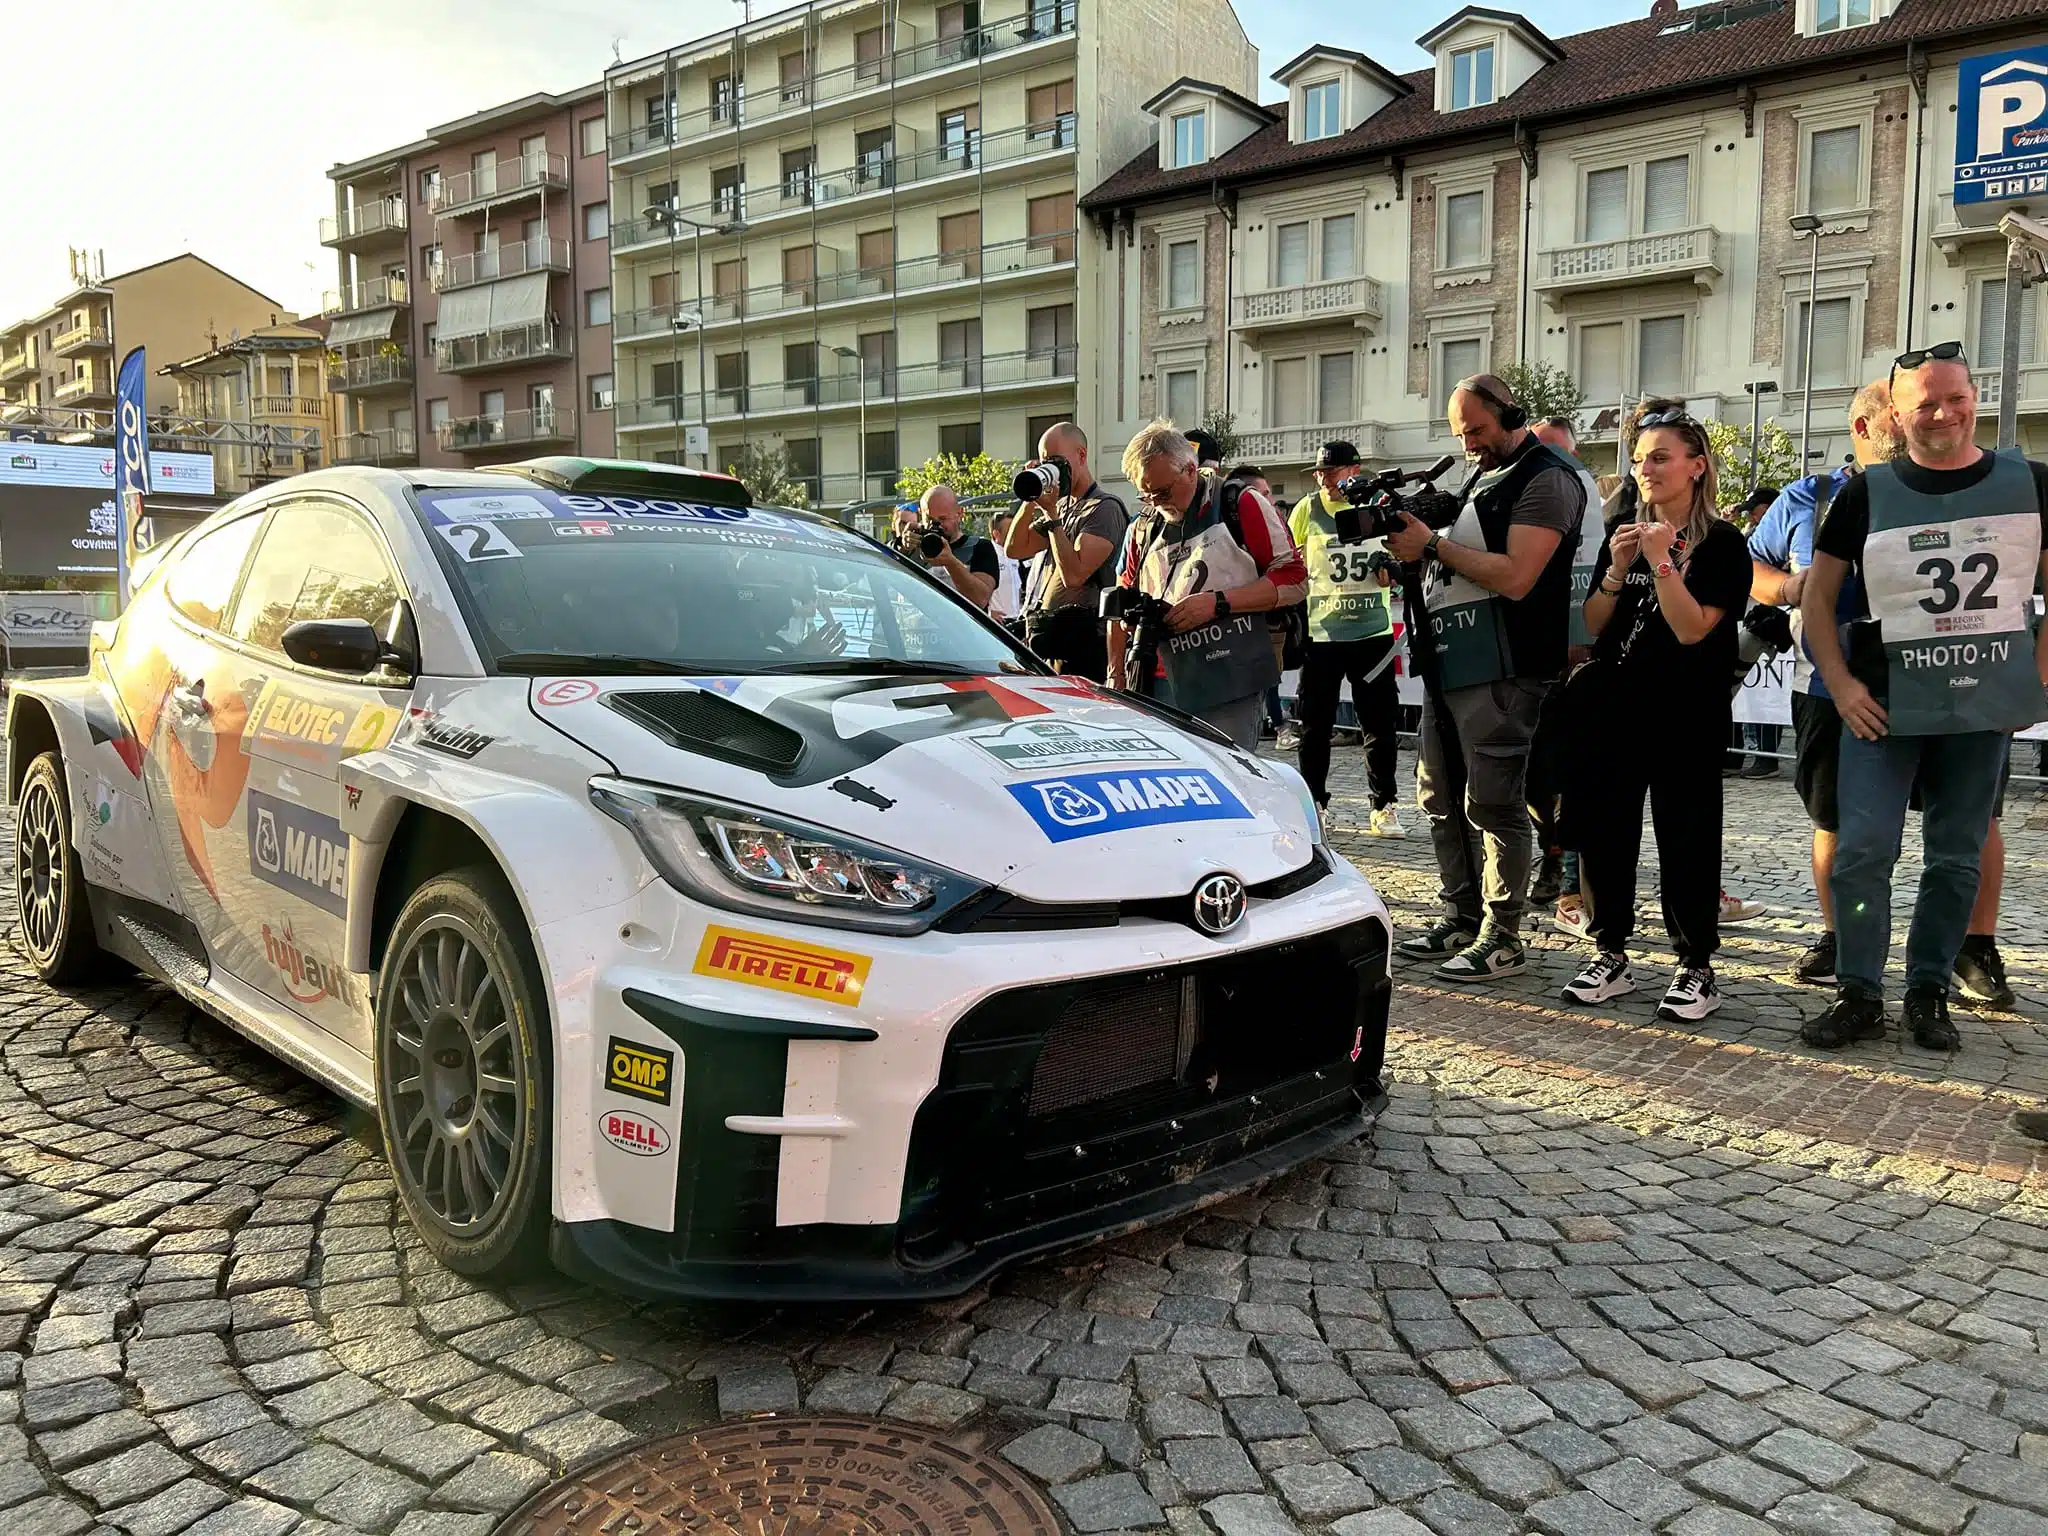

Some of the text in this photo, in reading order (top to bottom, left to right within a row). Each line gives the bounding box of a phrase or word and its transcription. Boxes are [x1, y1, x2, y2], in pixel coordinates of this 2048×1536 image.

[1977, 80, 2046, 155] P
[1980, 165, 2014, 175] Piazza
[2017, 160, 2037, 170] San
[559, 495, 788, 529] sparco
[450, 525, 509, 558] 2
[556, 526, 612, 536] GR
[612, 523, 701, 535] TOYOTA
[703, 527, 777, 541] GAZOO
[1329, 552, 1369, 583] 35
[1916, 553, 1999, 614] 32
[1318, 598, 1356, 610] PHOTO
[1364, 597, 1376, 609] TV
[1454, 609, 1476, 628] TV
[1169, 624, 1222, 654] PHOTO
[1233, 615, 1253, 634] TV
[1902, 643, 1977, 669] PHOTO
[1990, 640, 2009, 663] TV
[552, 684, 584, 698] E
[264, 696, 345, 745] ELIOTEC
[1097, 775, 1221, 813] MAPEI
[708, 935, 855, 993] PIRELLI
[612, 1053, 666, 1087] OMP
[608, 1115, 660, 1148] BELL
[613, 1137, 653, 1152] HELMETS
